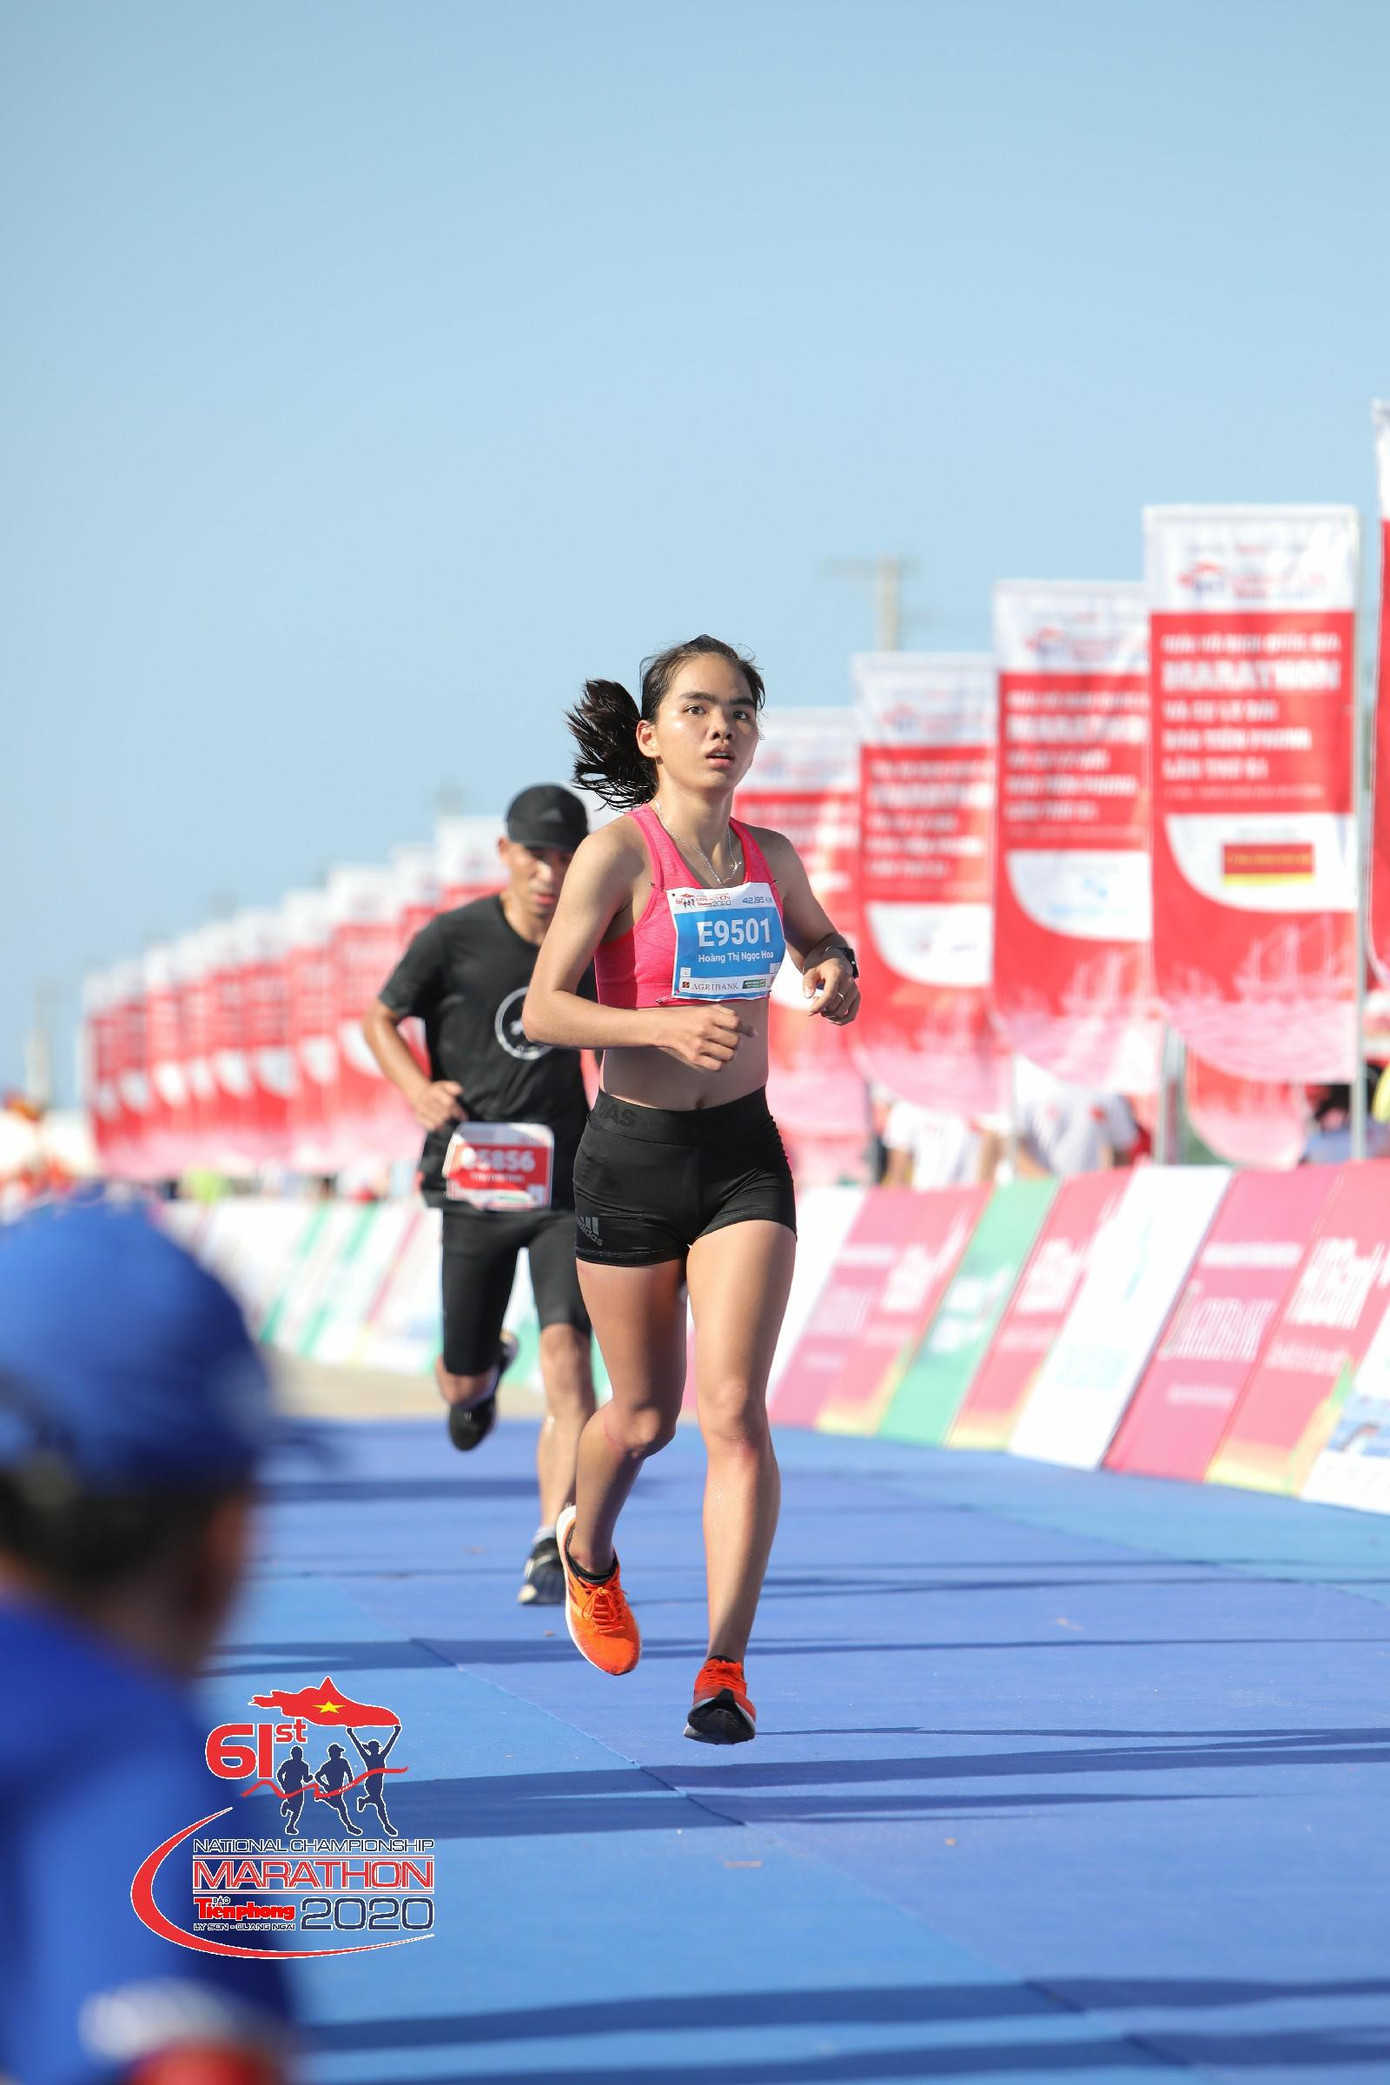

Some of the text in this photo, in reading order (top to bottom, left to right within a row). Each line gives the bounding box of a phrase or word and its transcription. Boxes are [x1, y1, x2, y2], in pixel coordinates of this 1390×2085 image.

[696, 918, 771, 947] E9501
[698, 950, 774, 963] Hoàng Thị Ngọc Hoa
[692, 982, 739, 992] AGRIBANK
